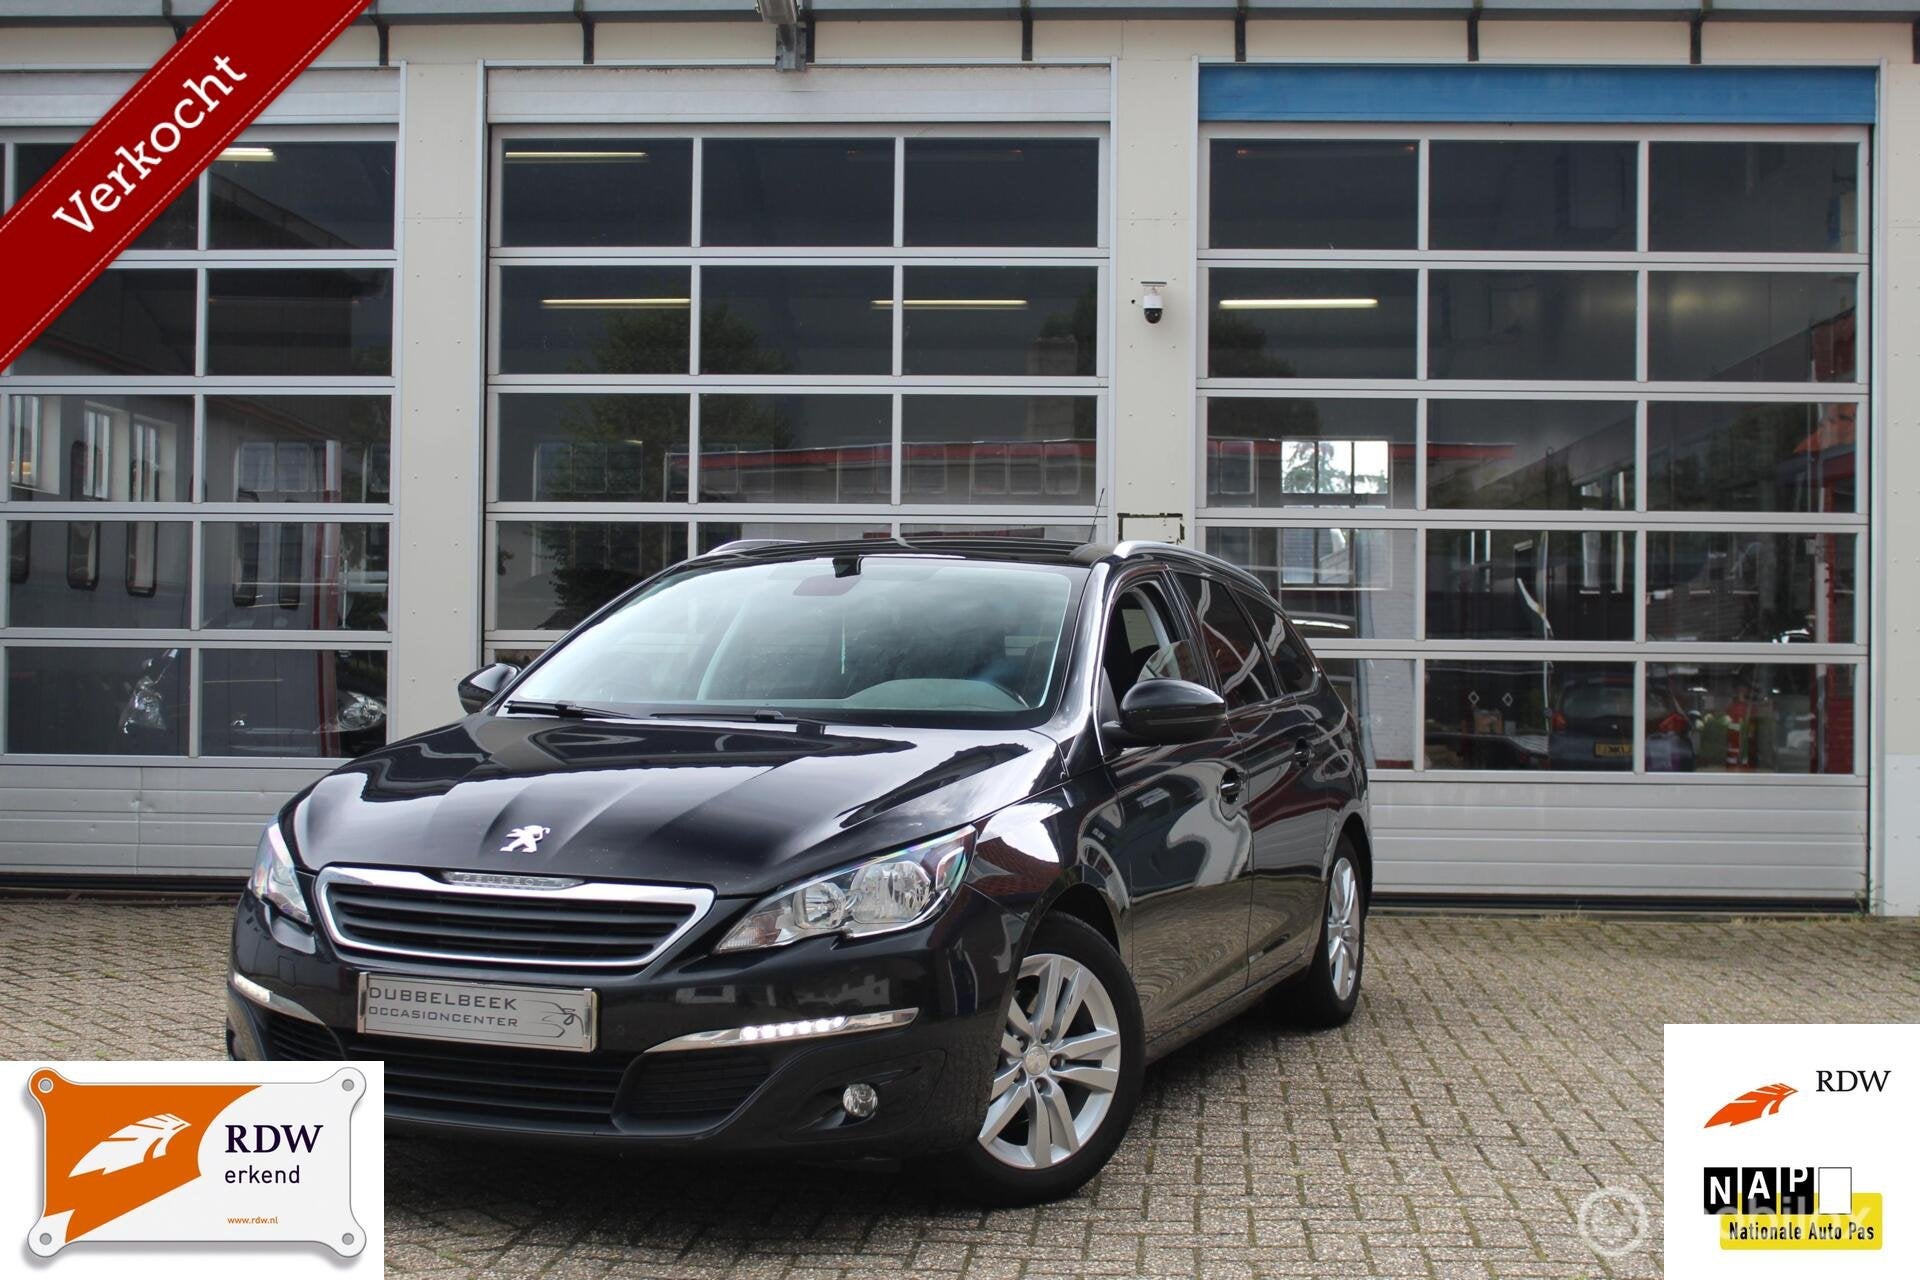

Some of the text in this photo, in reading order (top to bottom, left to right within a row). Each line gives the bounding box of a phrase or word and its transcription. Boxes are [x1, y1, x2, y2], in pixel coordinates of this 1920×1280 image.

[462, 874, 546, 887] PEUGEOT
[368, 987, 518, 1011] DUBBELBEEK
[368, 1005, 518, 1028] OCCASIONCENTER
